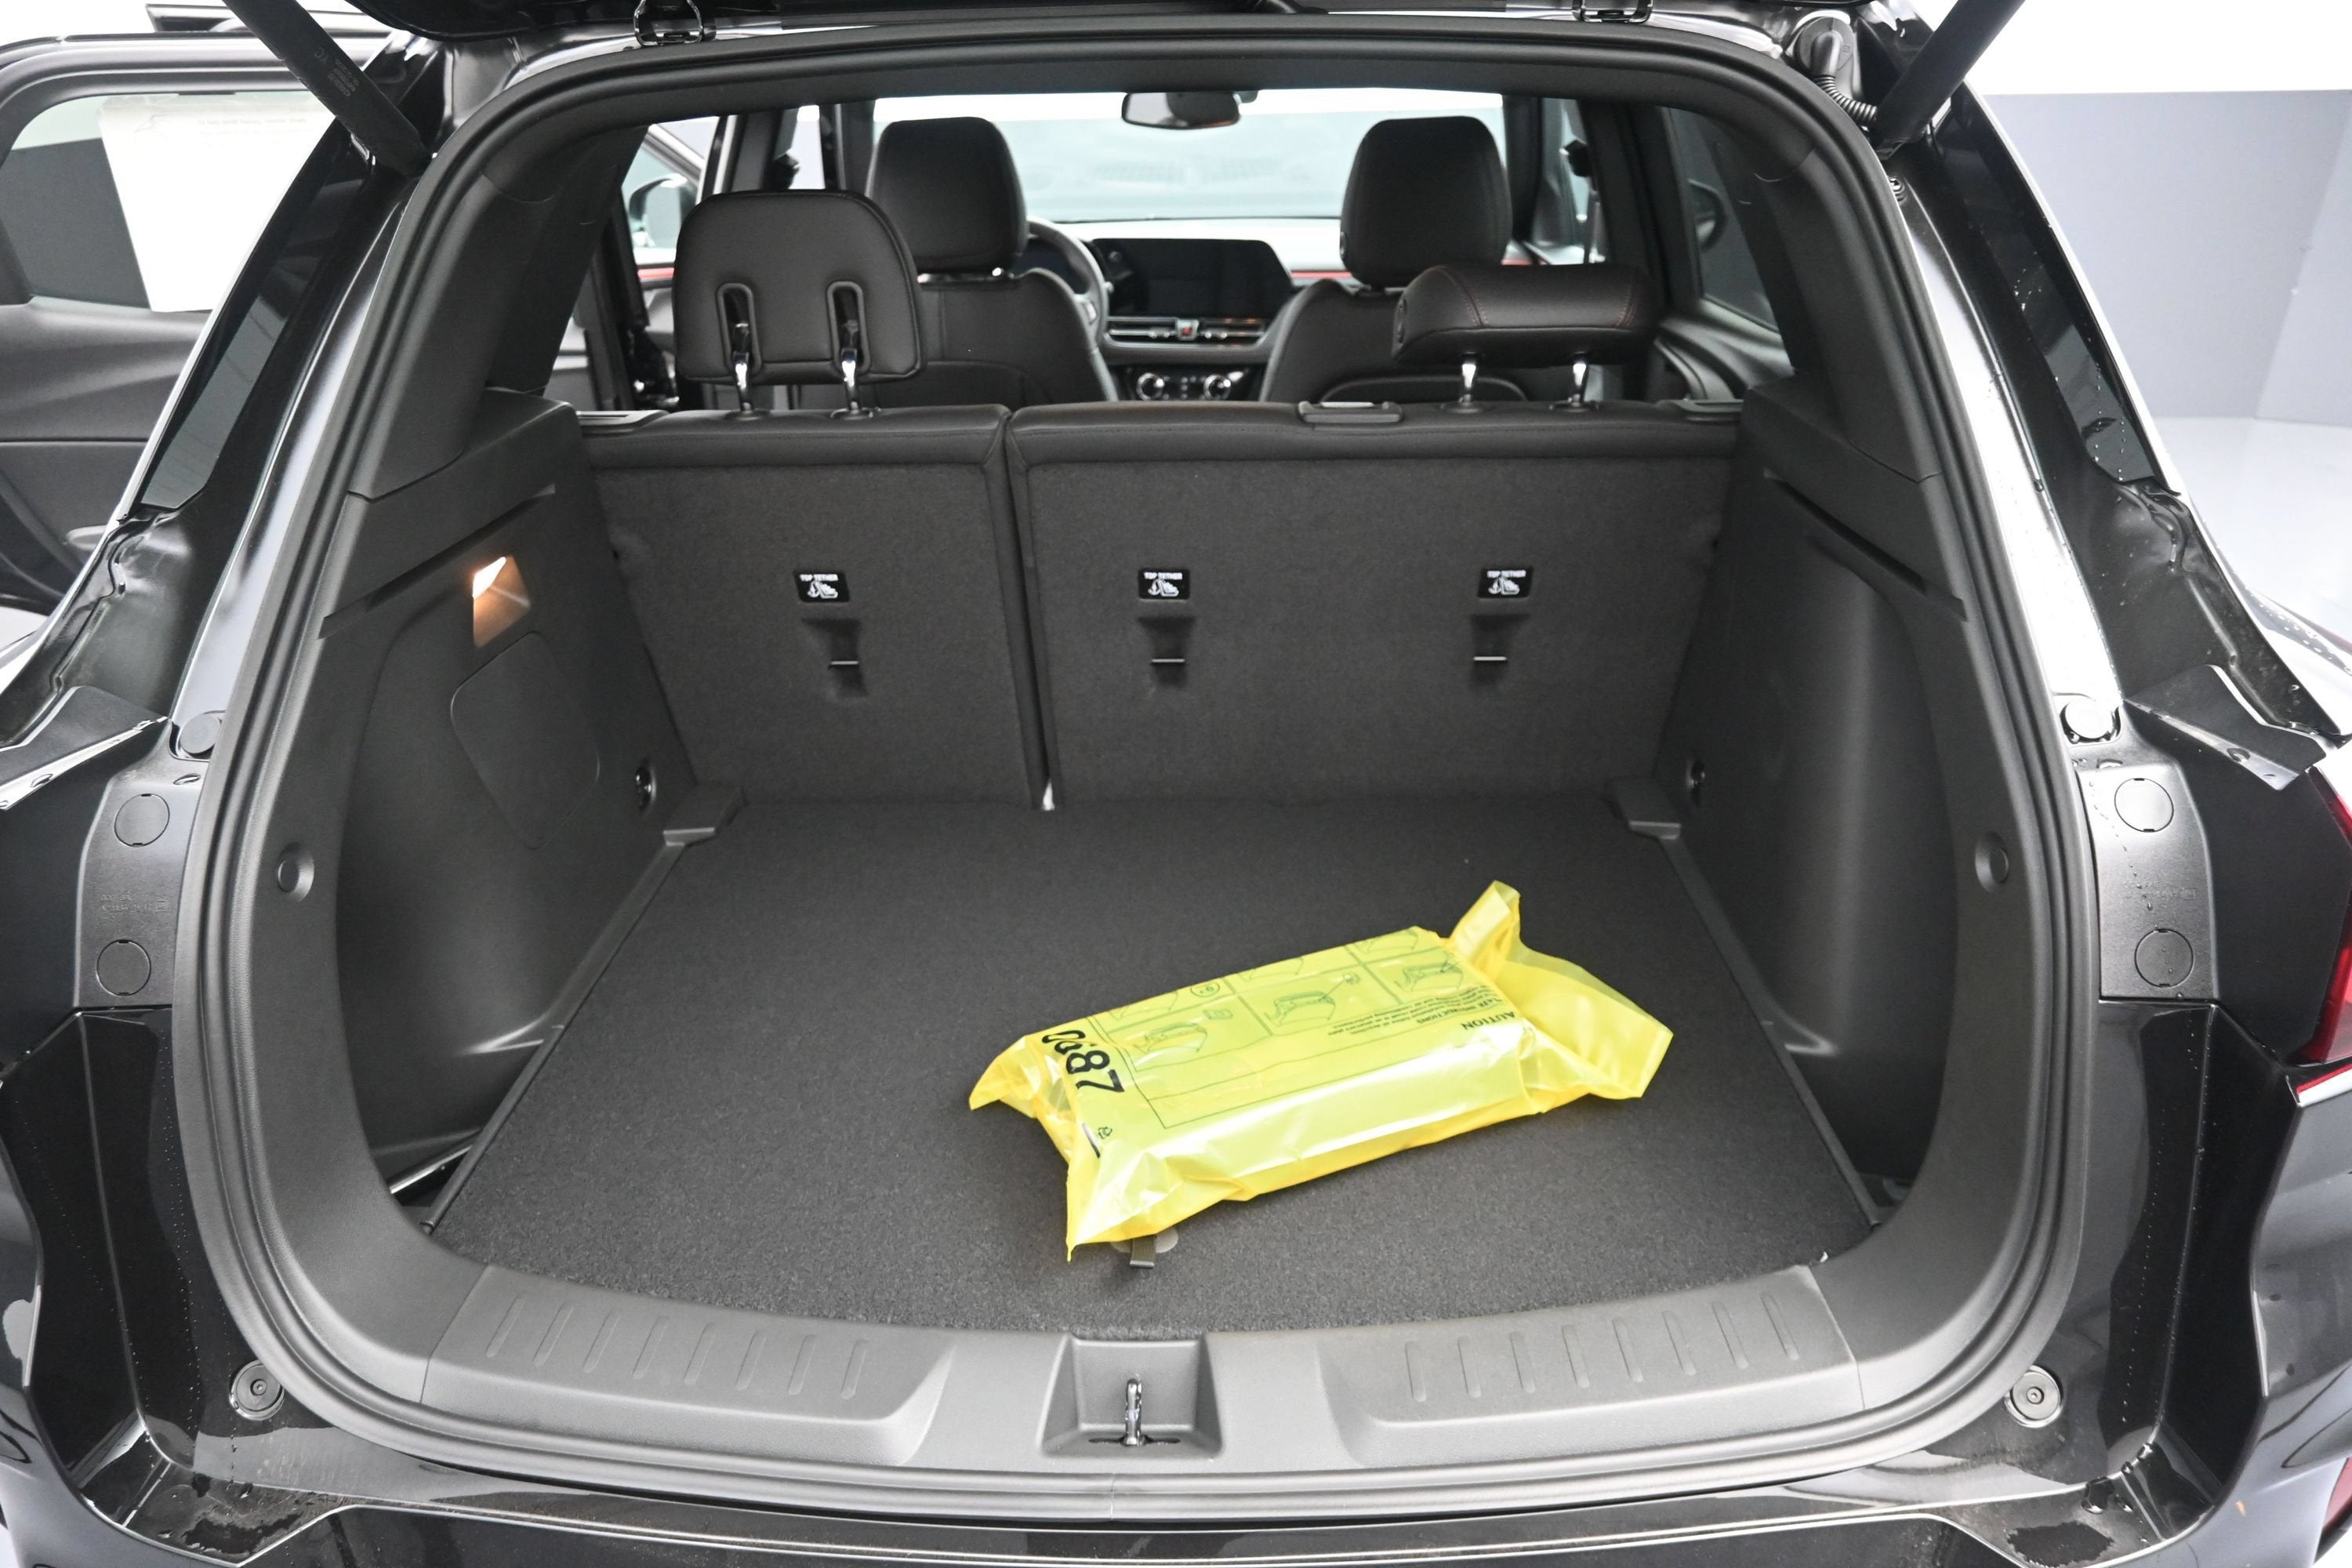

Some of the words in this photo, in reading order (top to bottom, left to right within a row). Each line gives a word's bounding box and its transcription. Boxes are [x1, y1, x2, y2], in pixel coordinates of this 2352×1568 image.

[1144, 572, 1158, 580] TOP
[1501, 570, 1526, 579] TETHER
[1461, 1011, 1515, 1030] AUTION
